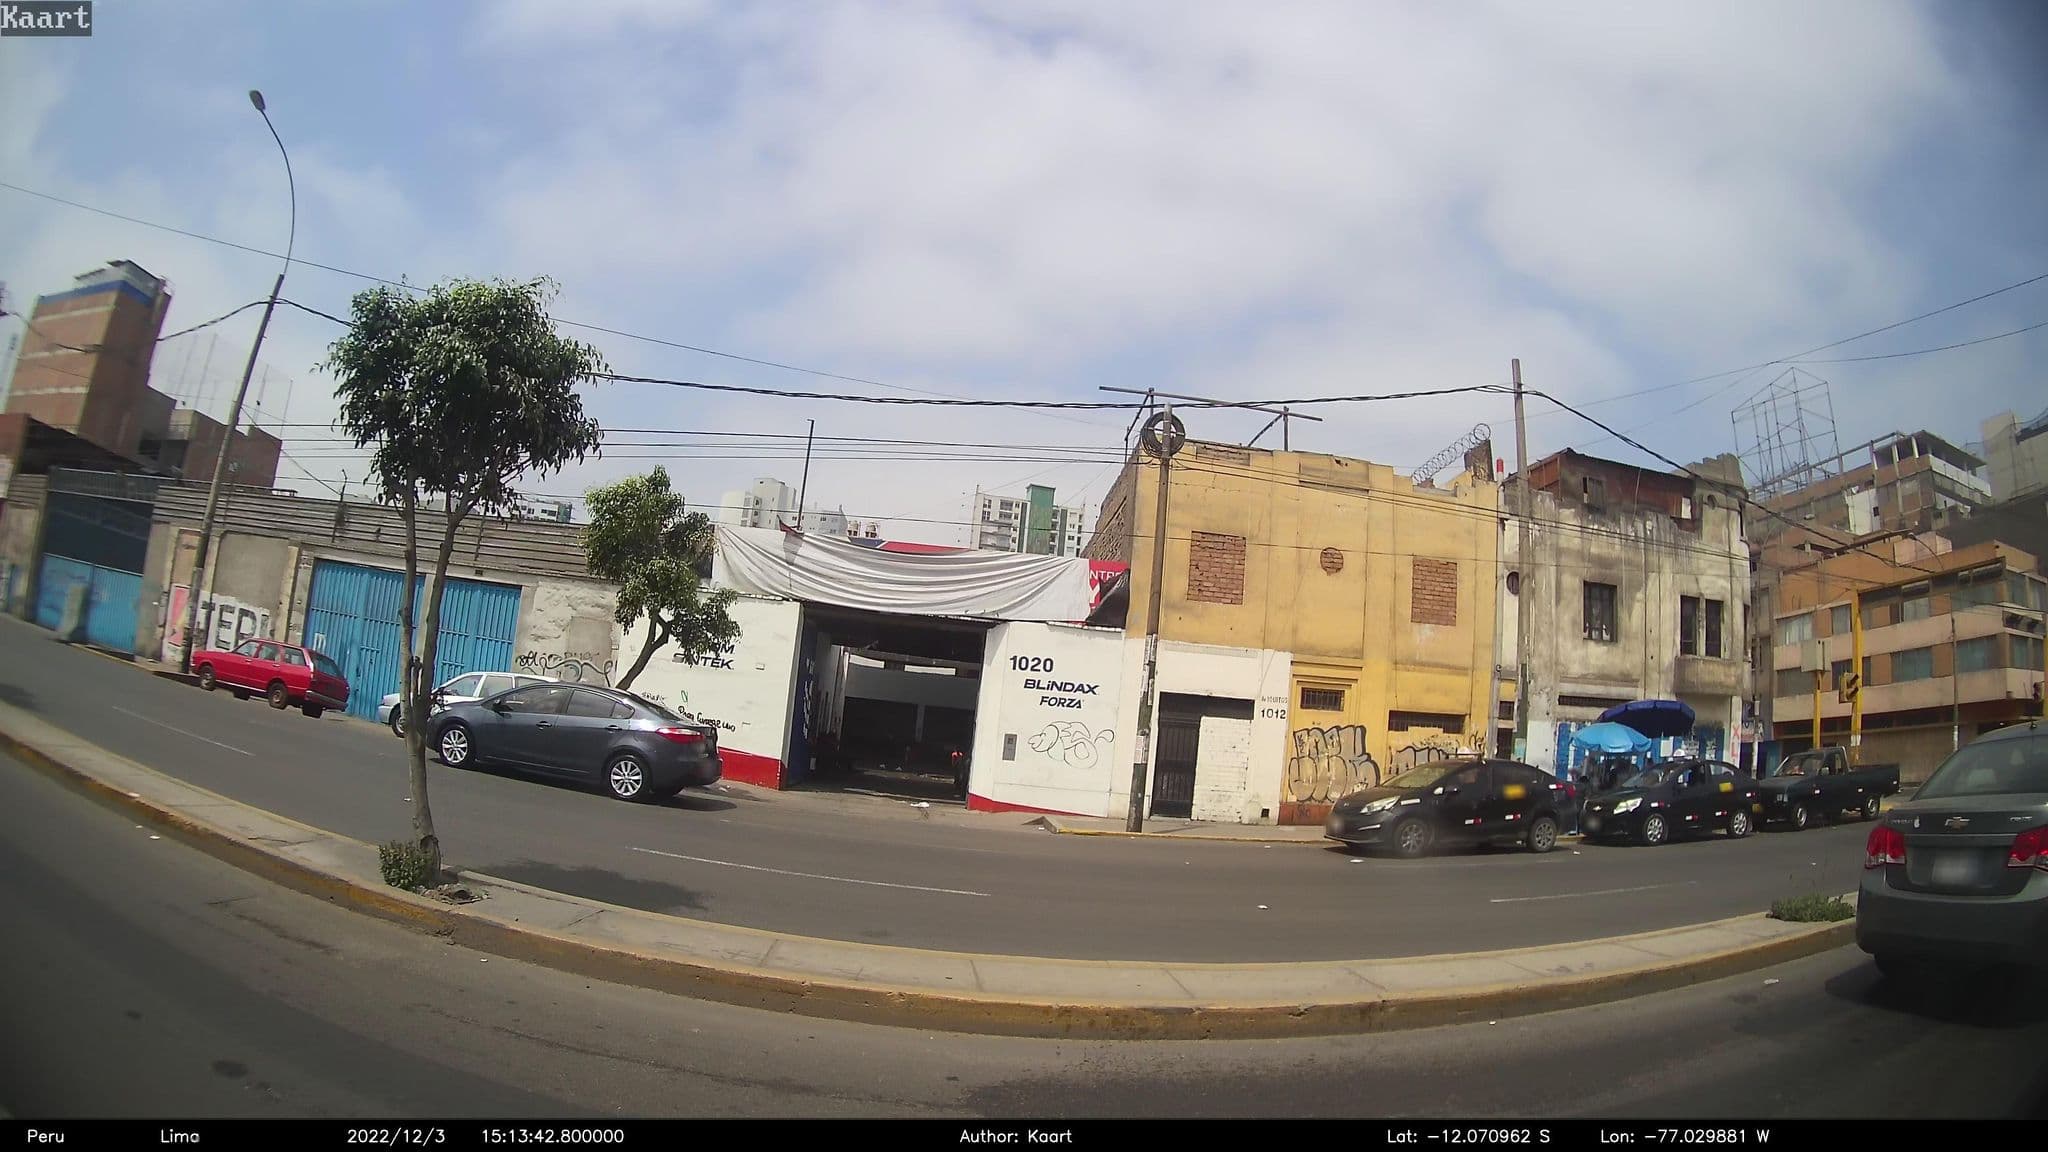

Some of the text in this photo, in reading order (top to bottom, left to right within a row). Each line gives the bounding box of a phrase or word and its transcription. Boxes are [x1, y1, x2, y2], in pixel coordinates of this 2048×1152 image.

[1009, 655, 1054, 673] 1020
[1039, 696, 1082, 709] FORZA
[1261, 708, 1286, 720] 1012
